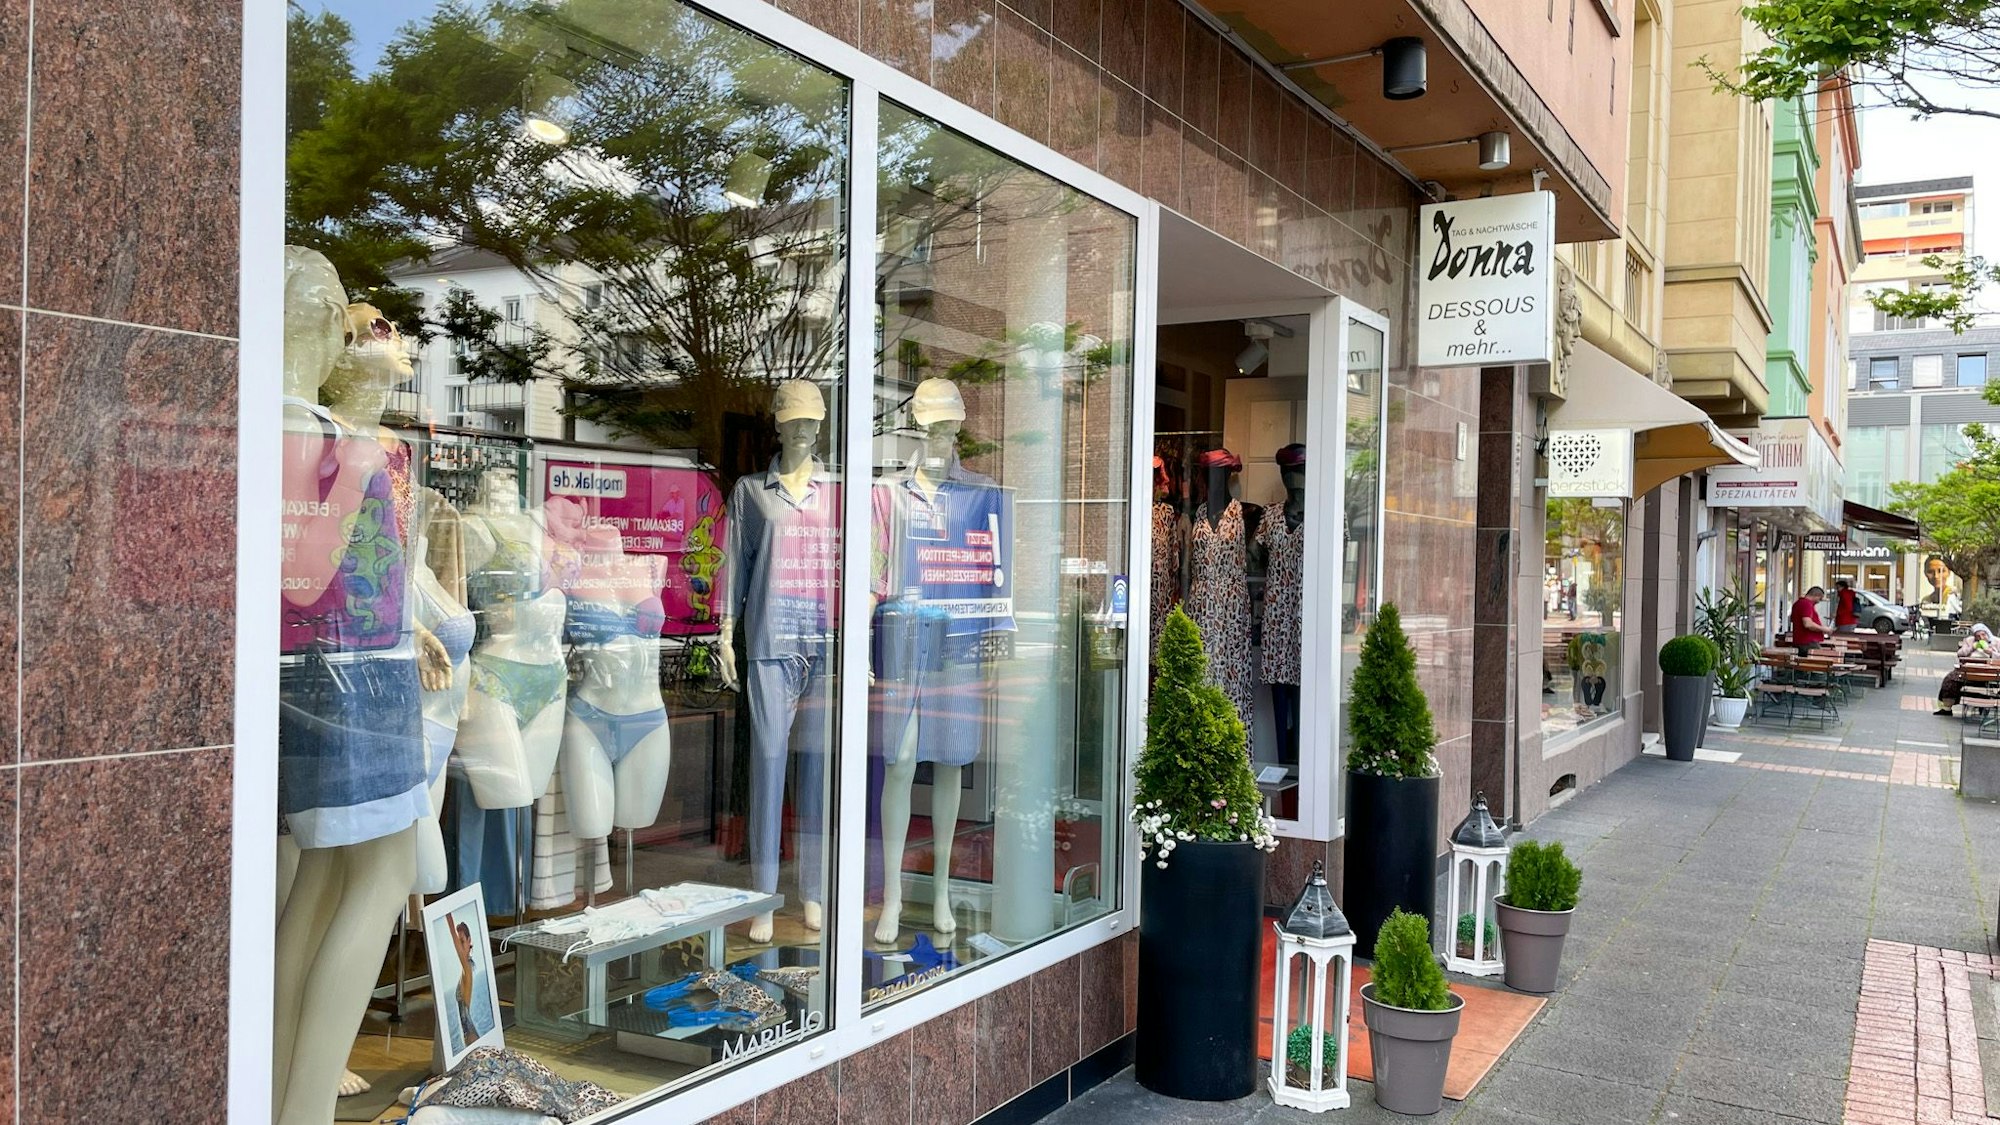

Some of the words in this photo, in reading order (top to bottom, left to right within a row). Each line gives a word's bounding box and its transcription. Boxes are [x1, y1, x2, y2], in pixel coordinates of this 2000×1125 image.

[1451, 229, 1467, 237] TAG
[1476, 221, 1538, 234] NACHTWÄSCHE
[1428, 210, 1535, 281] Donna
[1428, 296, 1535, 320] DESSOUS
[1474, 319, 1487, 335] &
[1447, 339, 1512, 357] mehr...
[1551, 477, 1626, 493] herzstück
[722, 1020, 793, 1064] MARIE
[798, 1008, 823, 1042] JO
